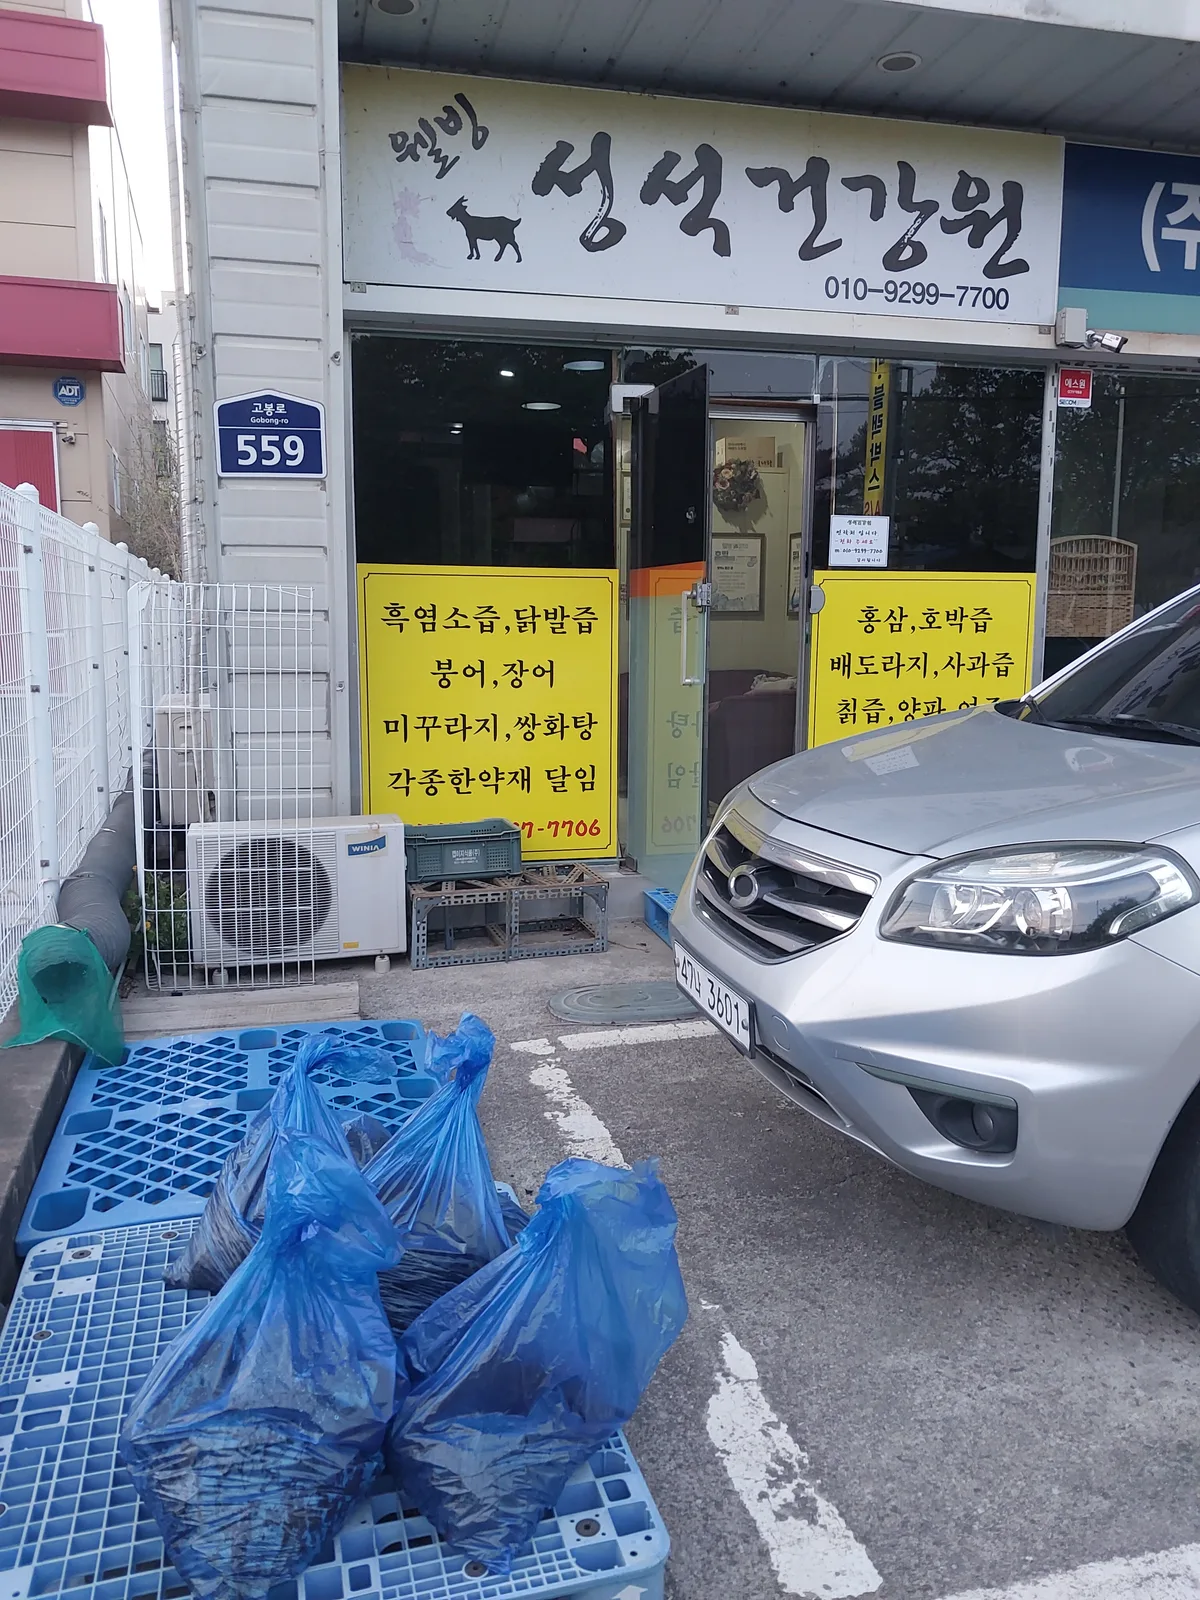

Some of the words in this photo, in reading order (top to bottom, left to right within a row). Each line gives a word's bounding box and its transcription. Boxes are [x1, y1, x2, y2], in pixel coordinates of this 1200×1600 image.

[388, 92, 490, 179] 웰빙
[824, 276, 1010, 310] 010-9299-7700
[59, 385, 80, 397] ADT
[1064, 378, 1086, 389] 에스원
[250, 416, 289, 425] Gobong-ro
[251, 402, 287, 415] 고봉로
[236, 435, 305, 466] 559
[381, 602, 599, 635] 흑염소즙,닭발즙
[857, 605, 993, 635] 홍삼,호박즙
[430, 658, 555, 690] 붕어,장어
[830, 651, 1015, 680] 배도라지,사과즙
[383, 711, 599, 743] 미꾸라지,쌍화탕
[388, 765, 531, 798] 각종한약재
[545, 764, 597, 793] 달임
[352, 844, 380, 853] WINIA
[707, 976, 740, 1035] 3601
